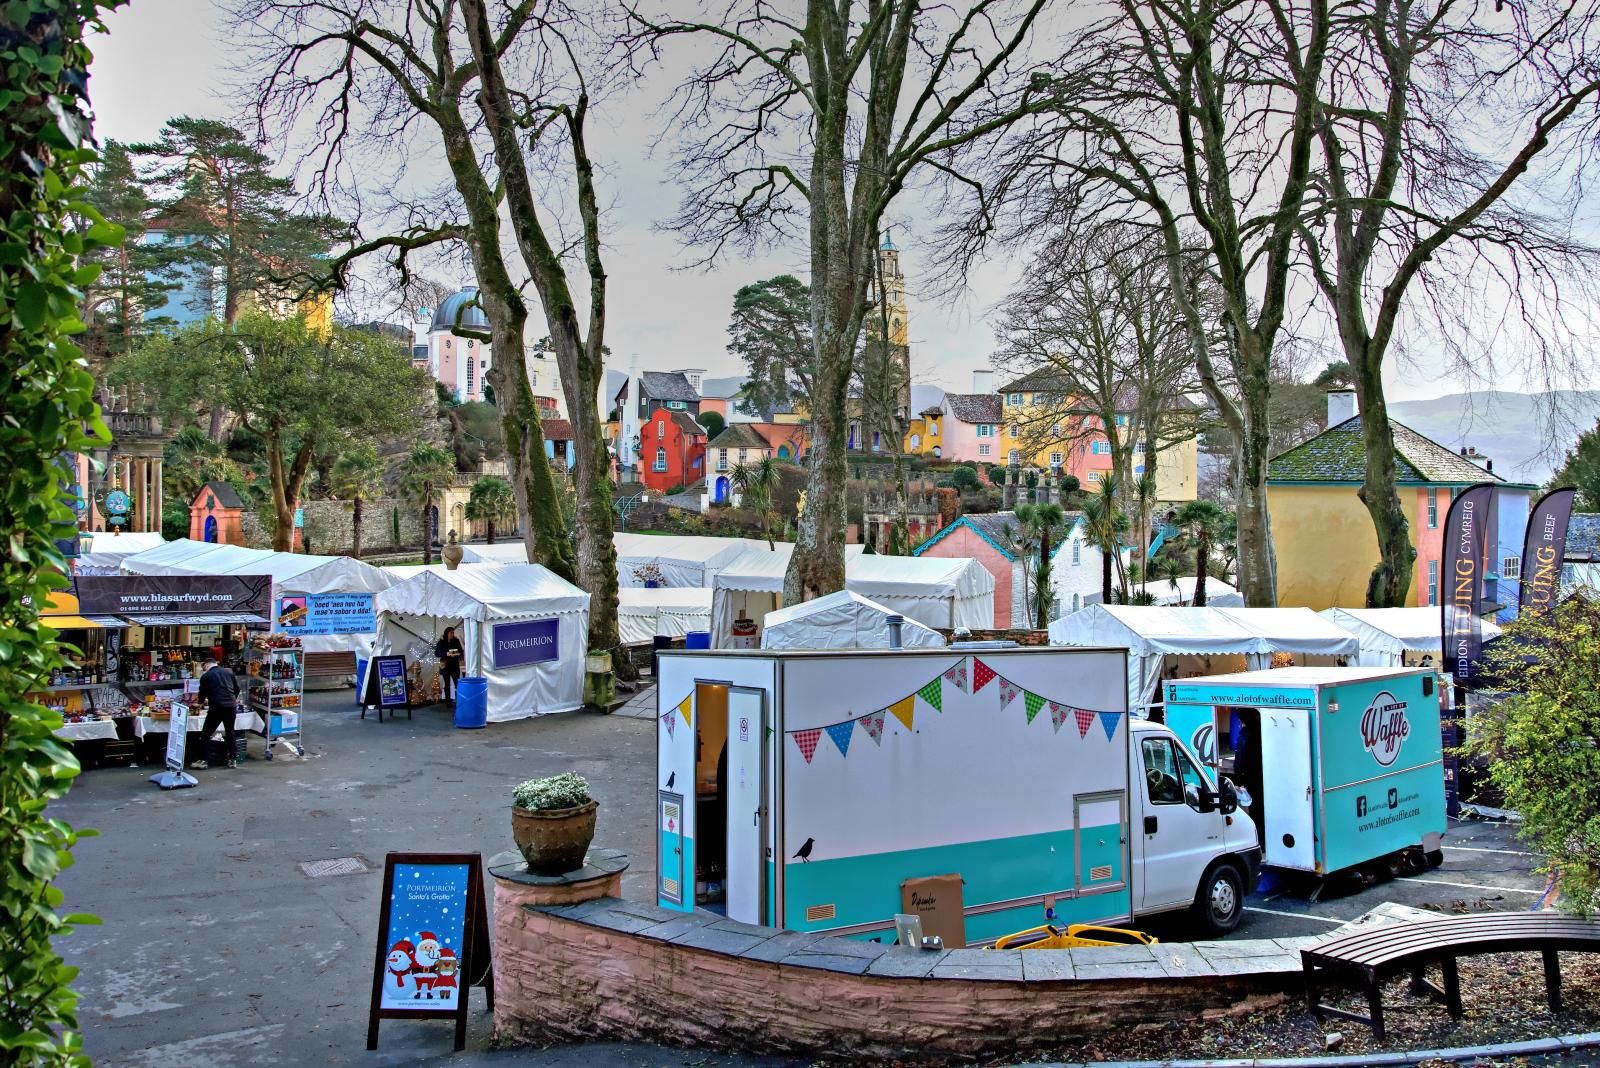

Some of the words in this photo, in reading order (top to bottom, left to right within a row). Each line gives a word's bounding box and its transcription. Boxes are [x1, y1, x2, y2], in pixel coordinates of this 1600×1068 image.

[1460, 500, 1474, 554] CYMREIG
[1543, 513, 1556, 541] BEEF
[120, 593, 233, 604] www.blasarfwyd.com
[1455, 558, 1475, 635] LUING
[498, 635, 553, 651] PORTMEIRION
[1458, 638, 1470, 678] EIDION
[1211, 693, 1313, 706] www.alotofwaffle.com
[1361, 706, 1409, 753] Waffle
[1358, 808, 1420, 833] www.alotofwaffle.com
[406, 884, 457, 892] PORTMEIRION
[408, 892, 430, 900] Santa's
